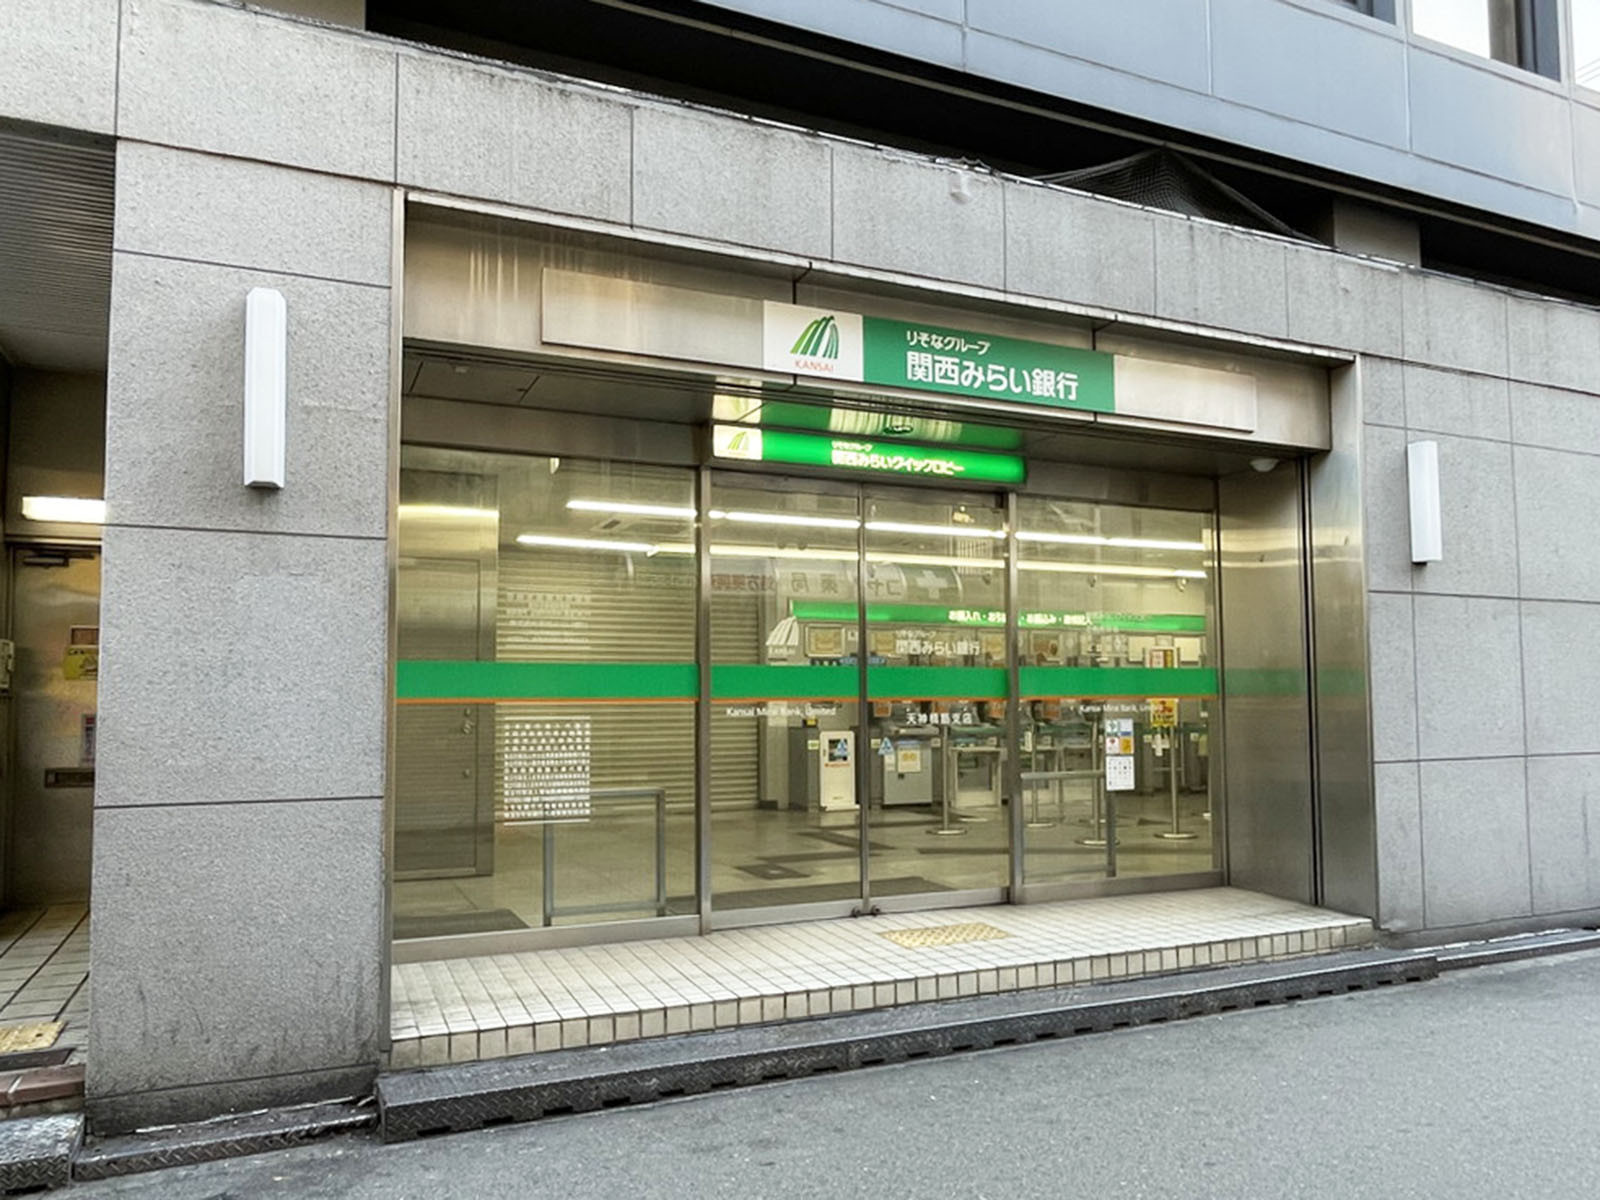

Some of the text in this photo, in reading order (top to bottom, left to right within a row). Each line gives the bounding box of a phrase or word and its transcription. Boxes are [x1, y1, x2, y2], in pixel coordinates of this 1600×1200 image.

[906, 330, 991, 355] りそなグループ
[794, 360, 834, 372] KANSAI
[906, 351, 1078, 401] 関西みらい銀行
